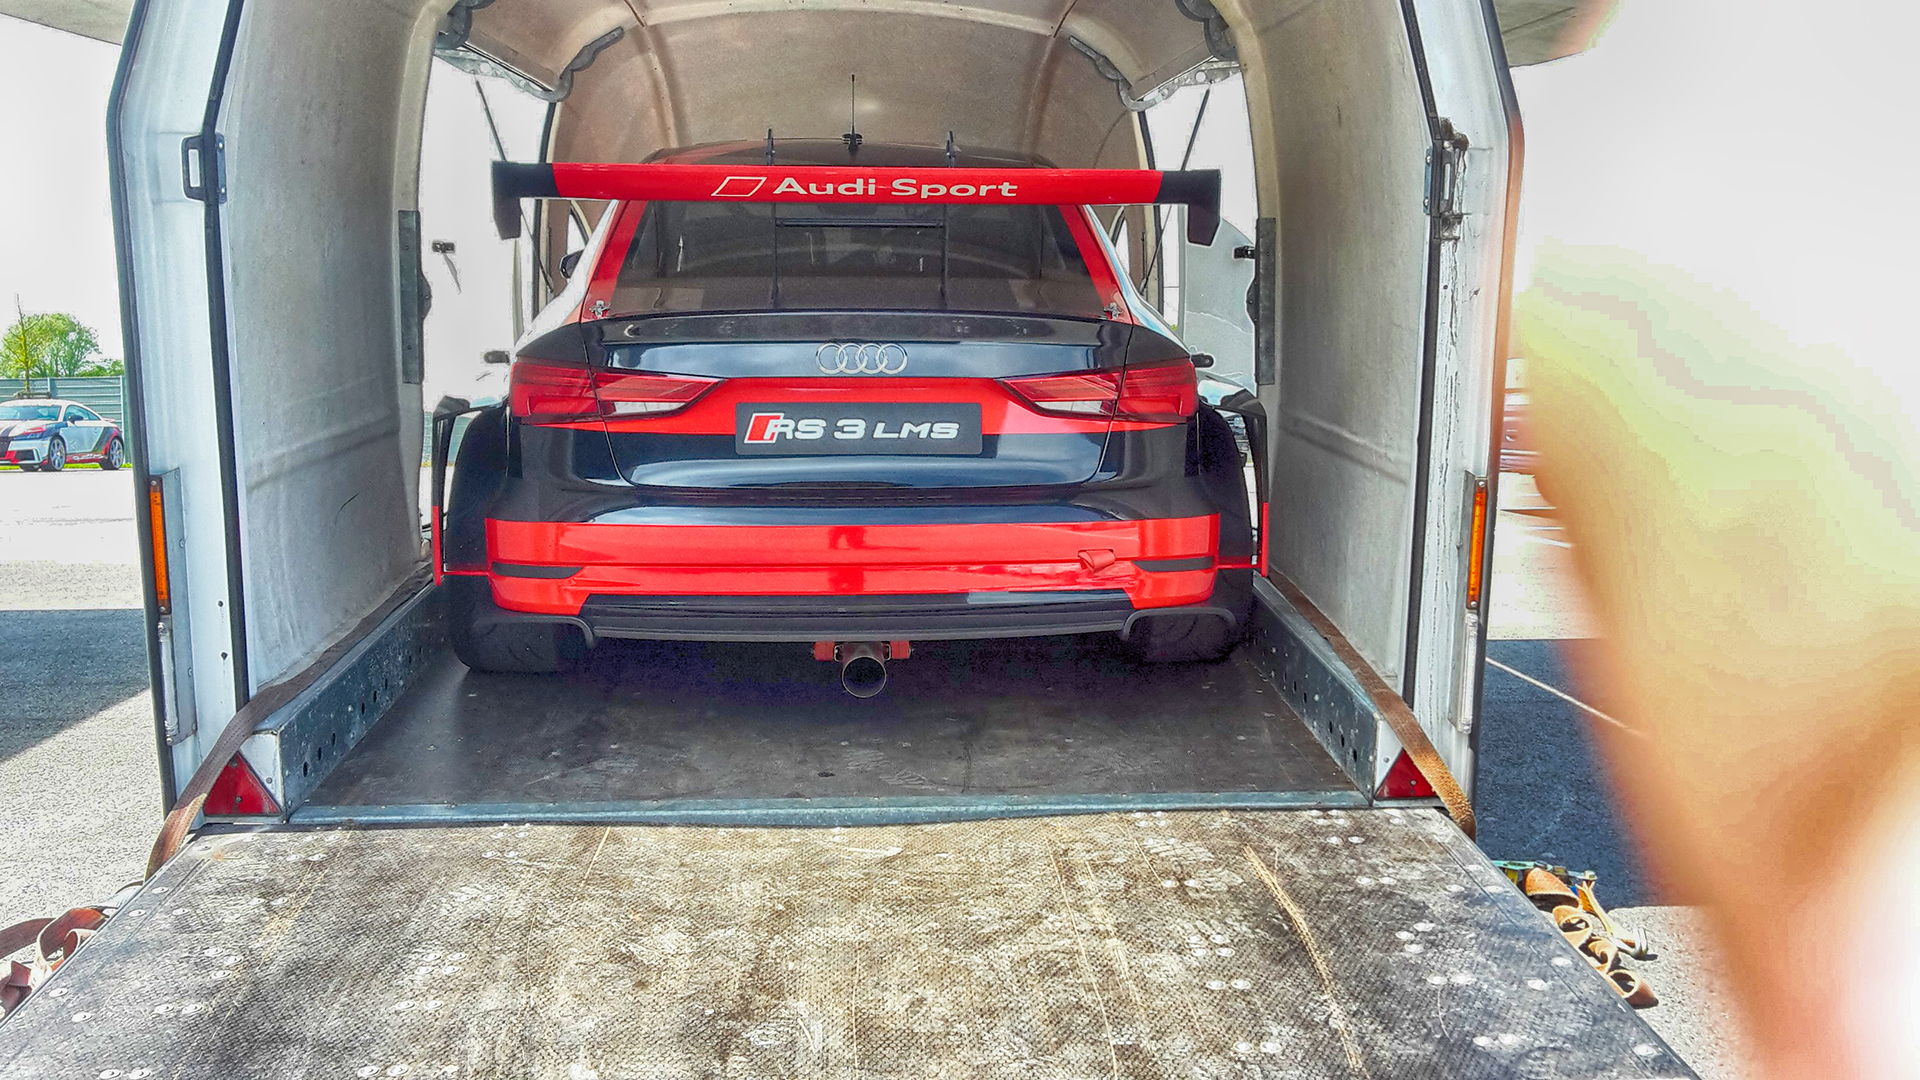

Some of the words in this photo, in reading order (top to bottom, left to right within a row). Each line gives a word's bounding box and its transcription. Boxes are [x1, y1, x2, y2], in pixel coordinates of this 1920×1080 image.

[772, 177, 876, 195] Audi
[890, 178, 1019, 198] Sport
[763, 418, 827, 440] RS
[833, 418, 867, 440] 3
[872, 422, 960, 439] LMS
